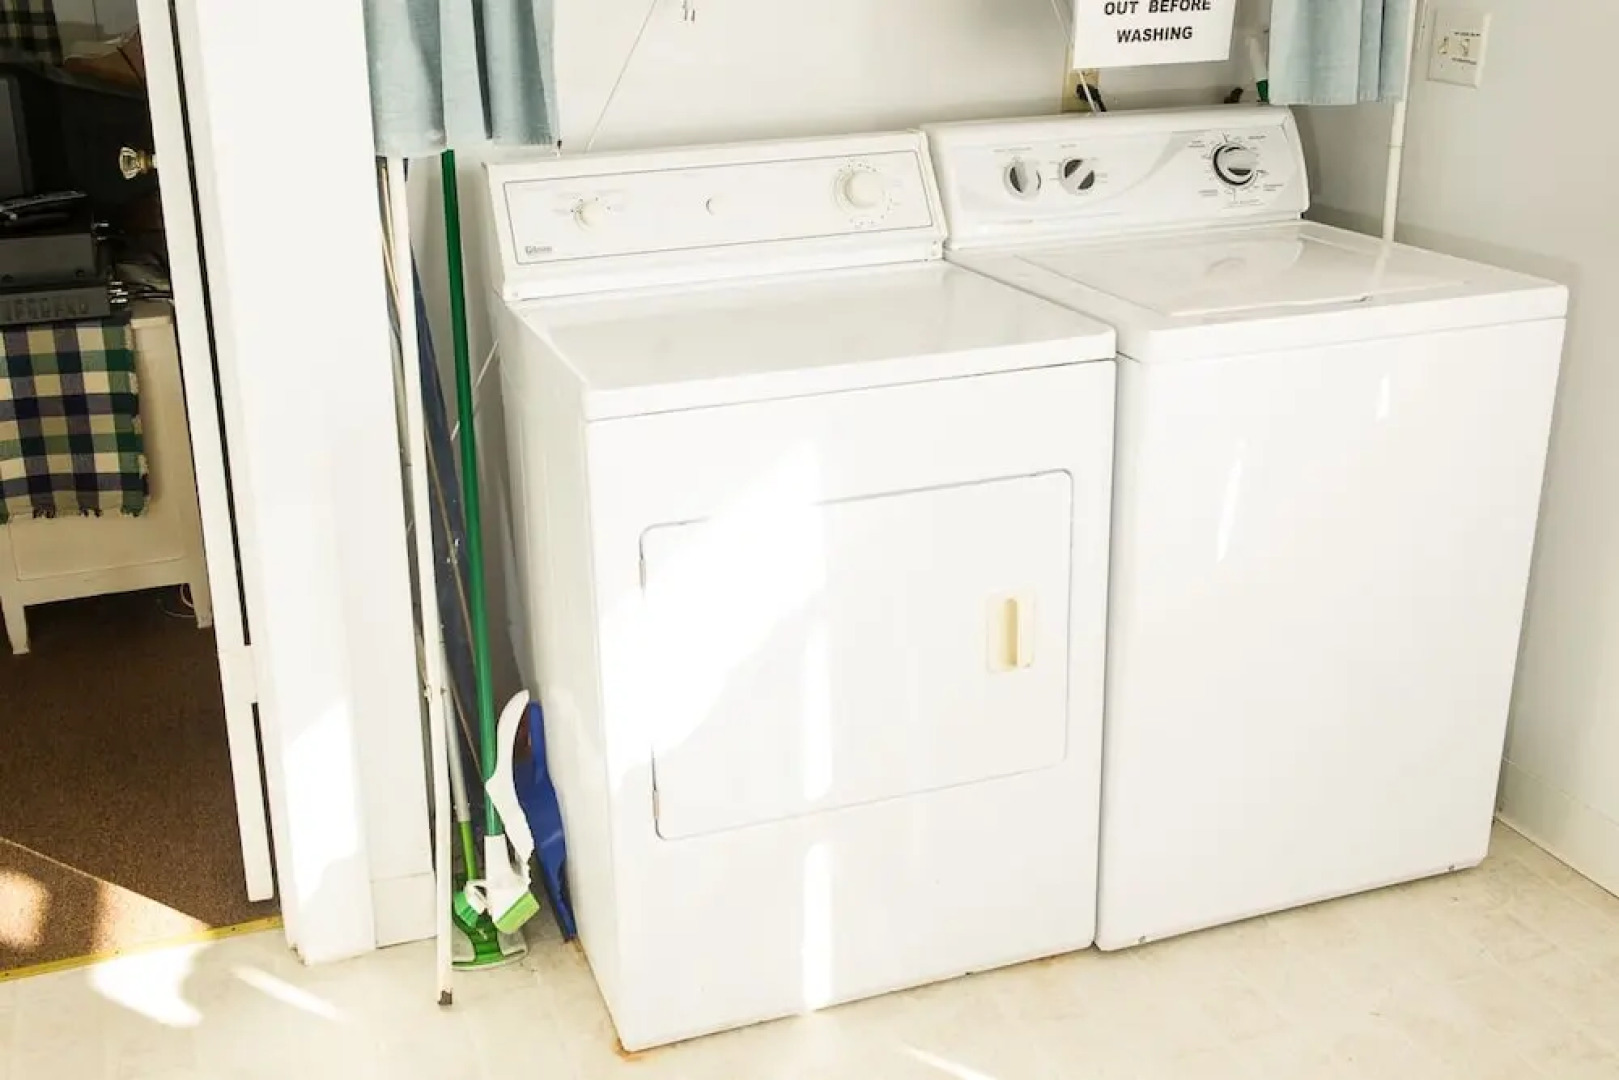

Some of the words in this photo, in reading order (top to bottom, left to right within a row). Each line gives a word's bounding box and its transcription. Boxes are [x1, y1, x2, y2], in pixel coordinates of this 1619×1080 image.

[1104, 1, 1138, 16] OUT
[1148, 0, 1211, 13] BEFORE
[1117, 26, 1193, 43] WASHING
